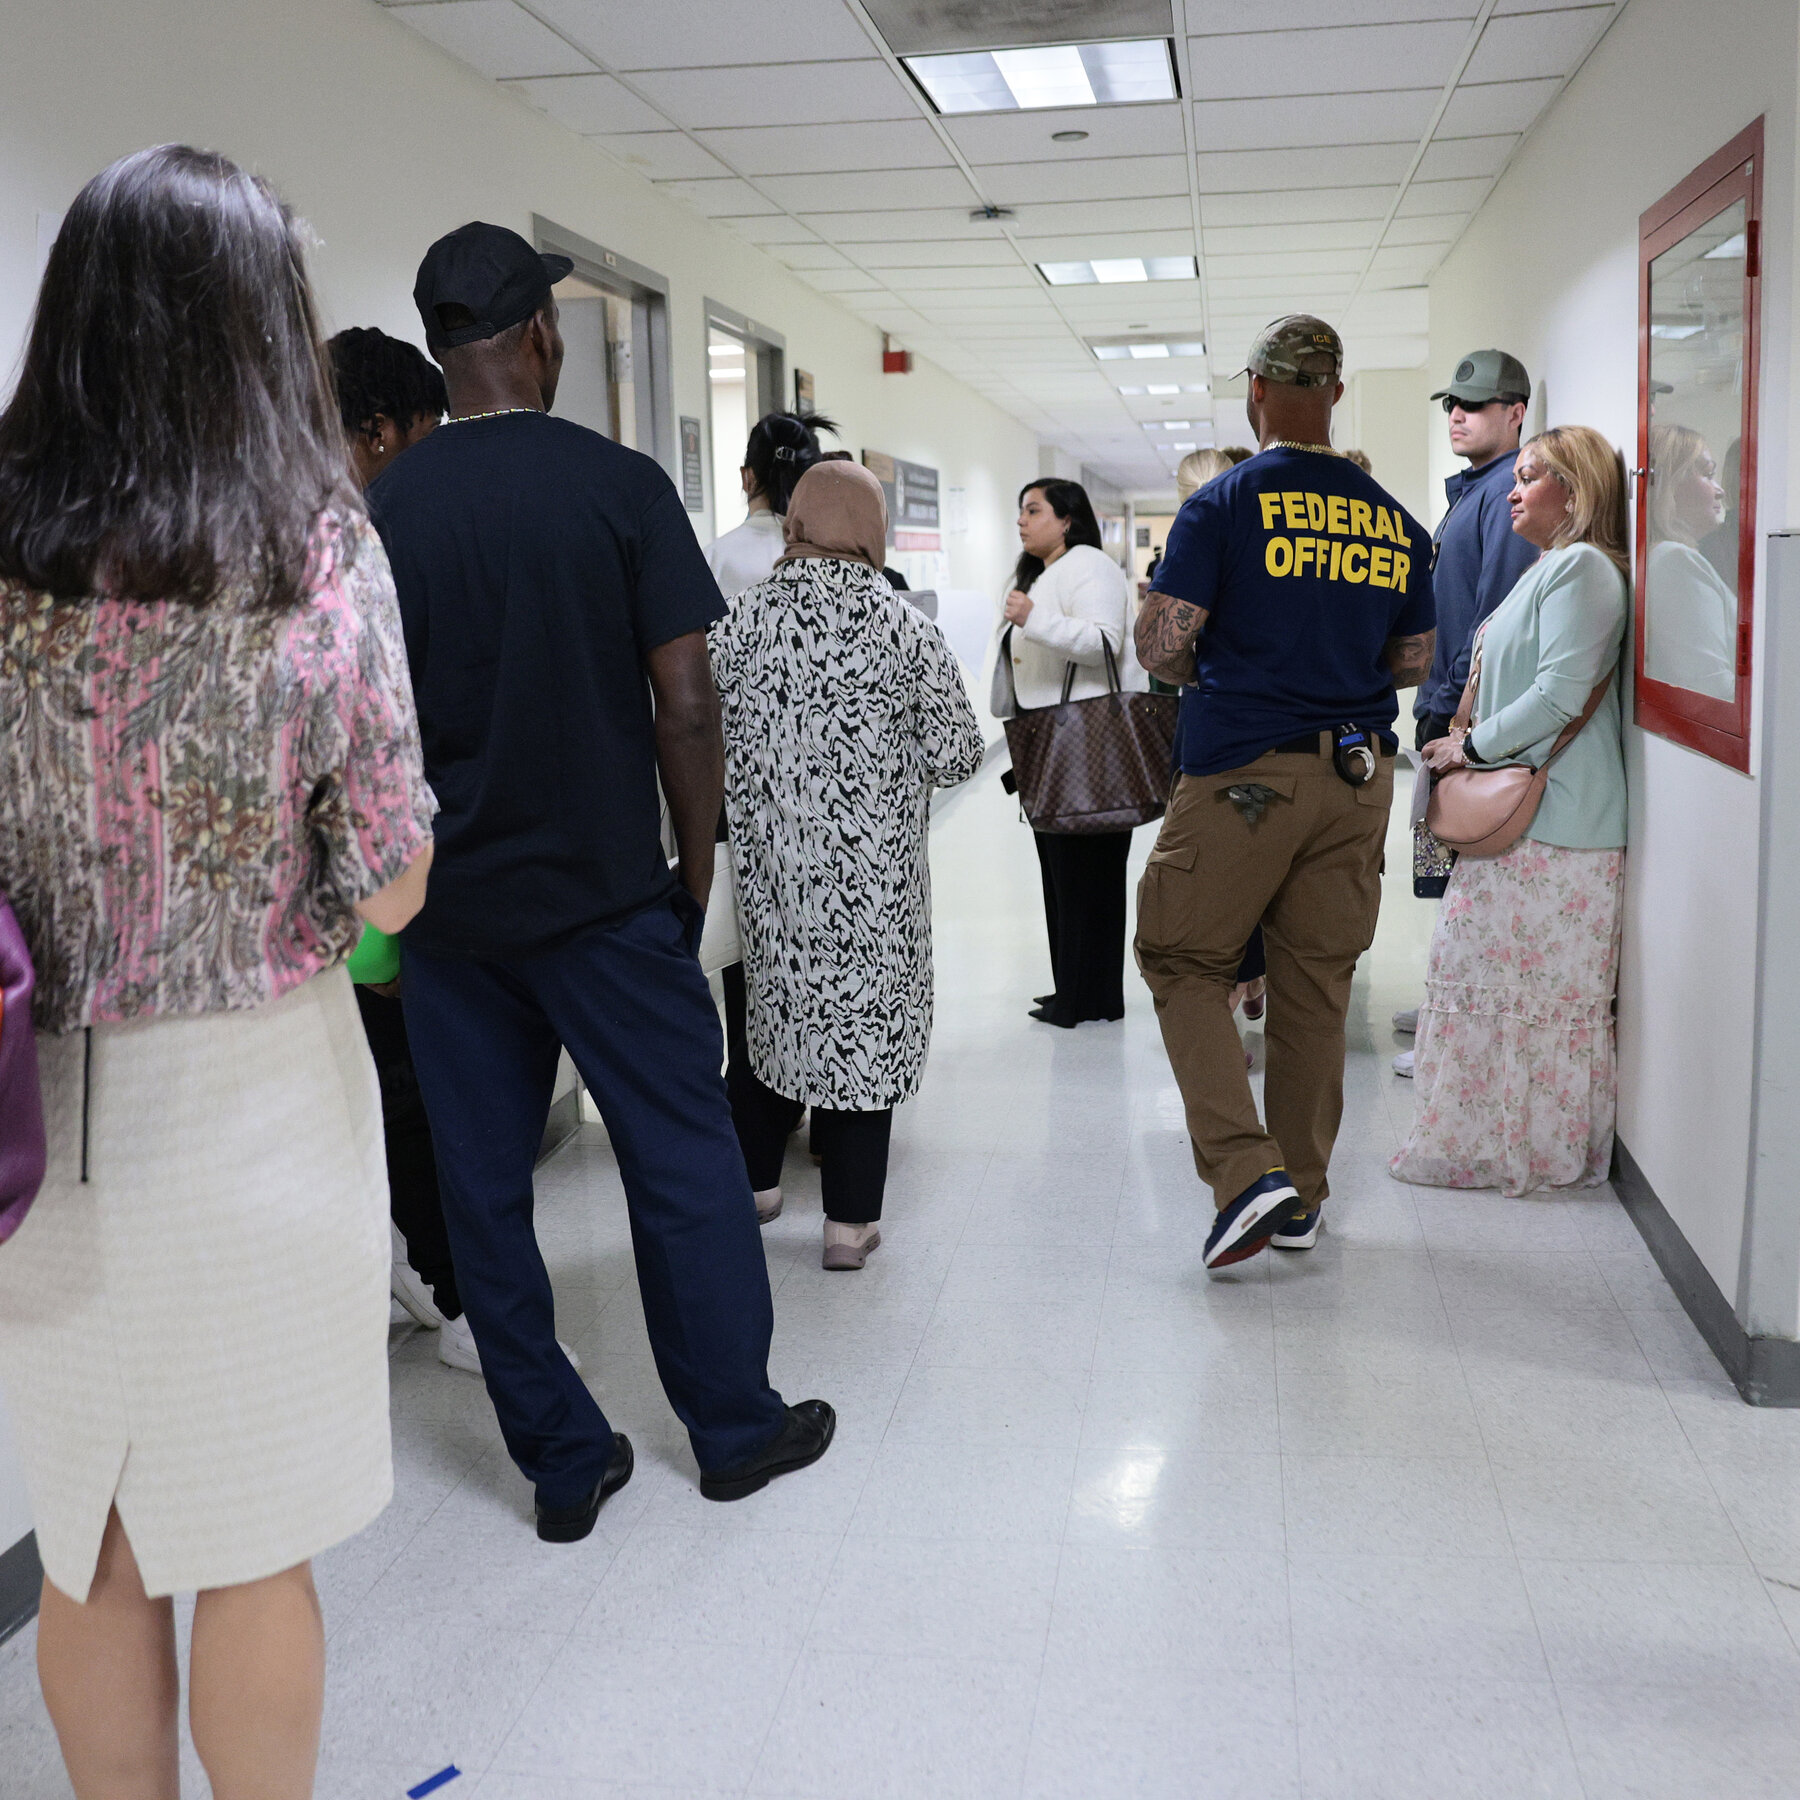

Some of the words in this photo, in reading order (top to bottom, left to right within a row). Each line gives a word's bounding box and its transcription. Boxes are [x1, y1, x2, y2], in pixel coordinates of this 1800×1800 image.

[1312, 334, 1331, 344] ICE
[1258, 491, 1412, 549] FEDERAL
[1265, 536, 1411, 594] OFFICER
